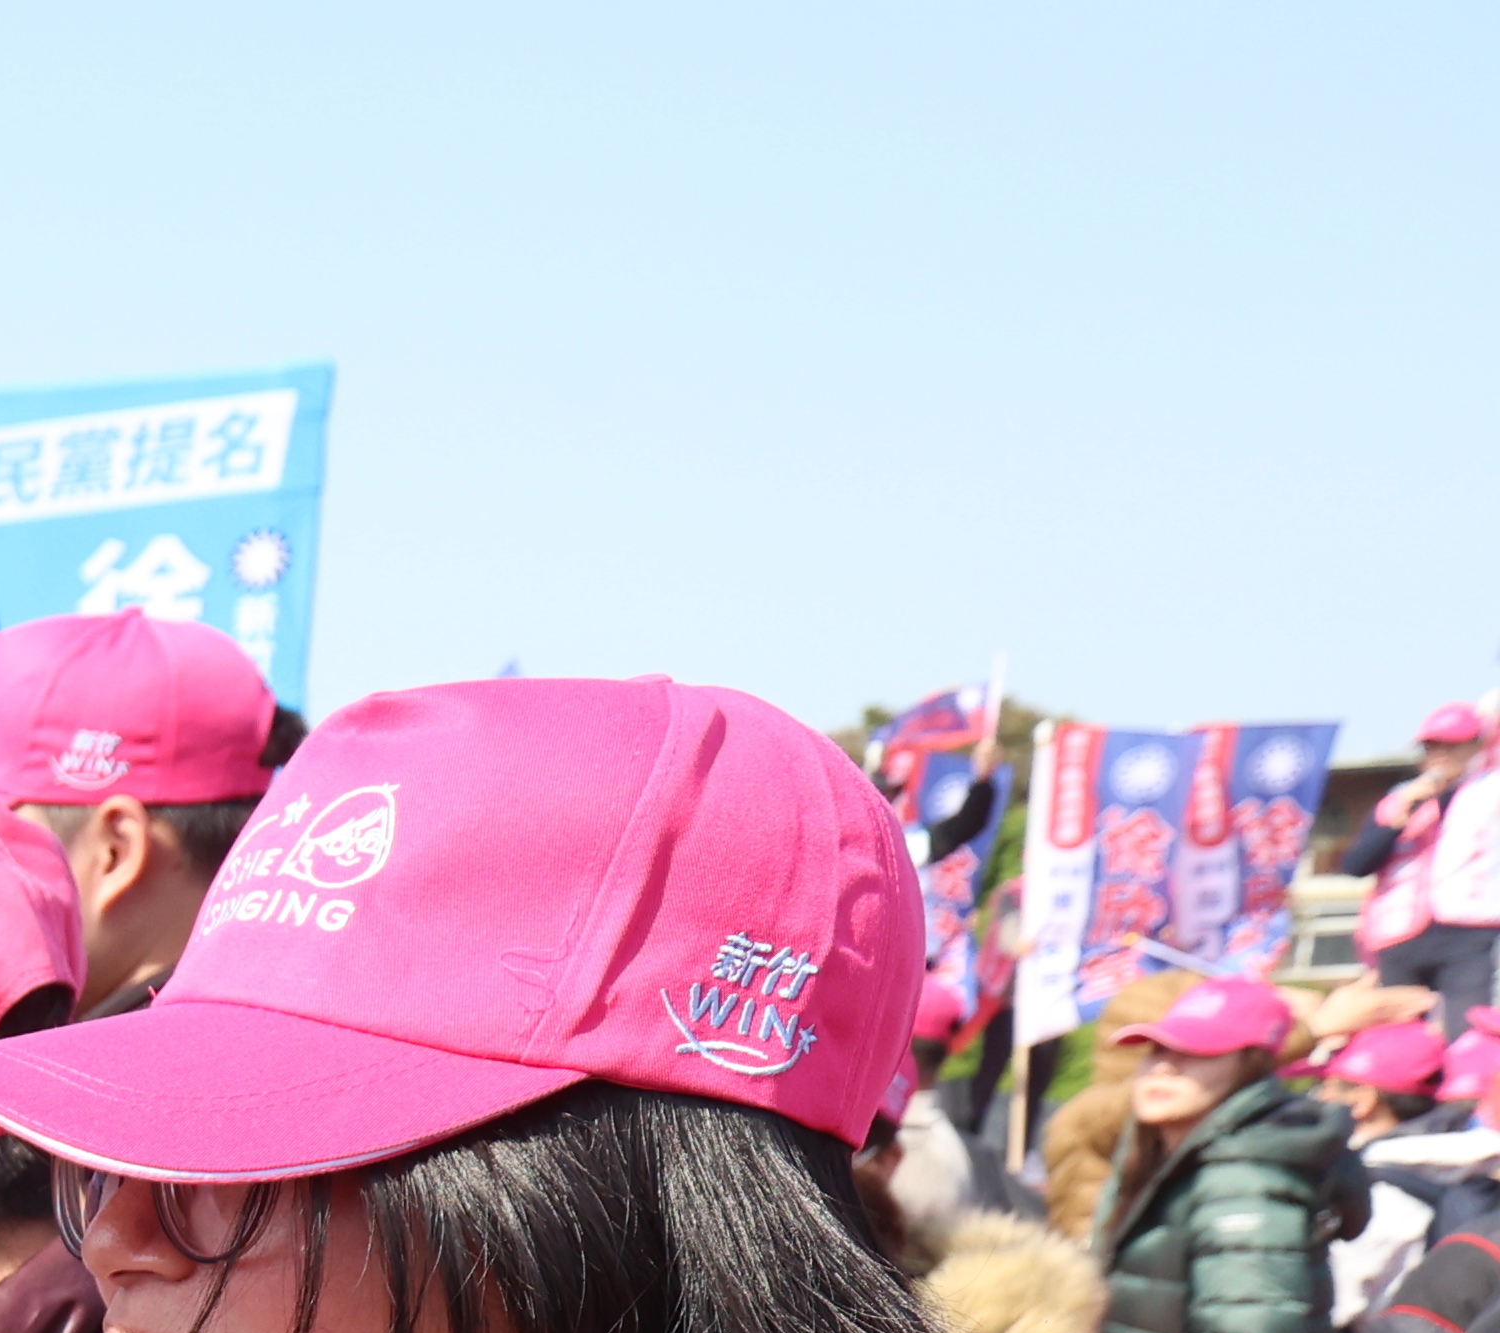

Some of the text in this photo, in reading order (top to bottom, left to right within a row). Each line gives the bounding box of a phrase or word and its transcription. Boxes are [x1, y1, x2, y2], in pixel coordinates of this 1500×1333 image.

[222, 847, 283, 891] SHE
[202, 888, 357, 936] SINGING
[710, 931, 821, 1000] 新竹
[689, 981, 800, 1050] WIN
